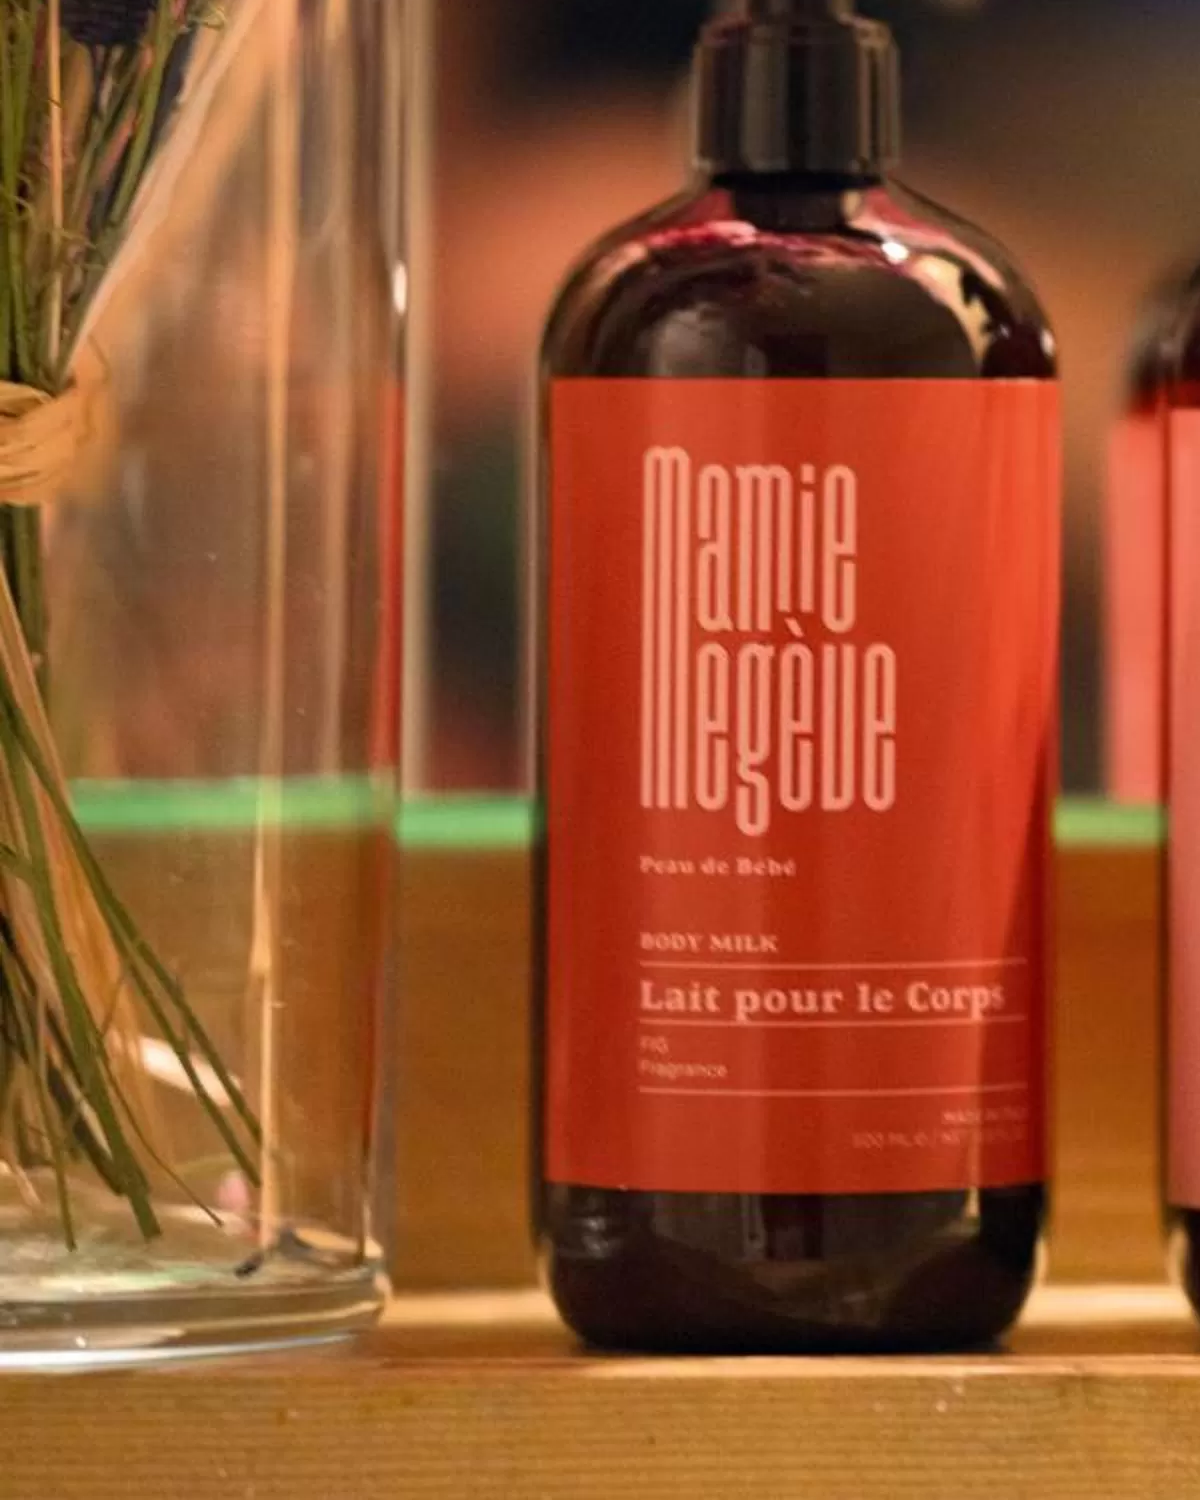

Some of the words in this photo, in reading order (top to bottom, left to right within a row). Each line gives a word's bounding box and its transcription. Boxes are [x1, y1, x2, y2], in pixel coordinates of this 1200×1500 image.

[642, 445, 858, 634] Mamie
[700, 856, 730, 876] de
[639, 932, 703, 952] BODY
[709, 934, 779, 953] MILK
[639, 979, 721, 1013] Lait
[734, 985, 844, 1025] pour
[856, 981, 895, 1013] le
[906, 980, 1005, 1022] Corps
